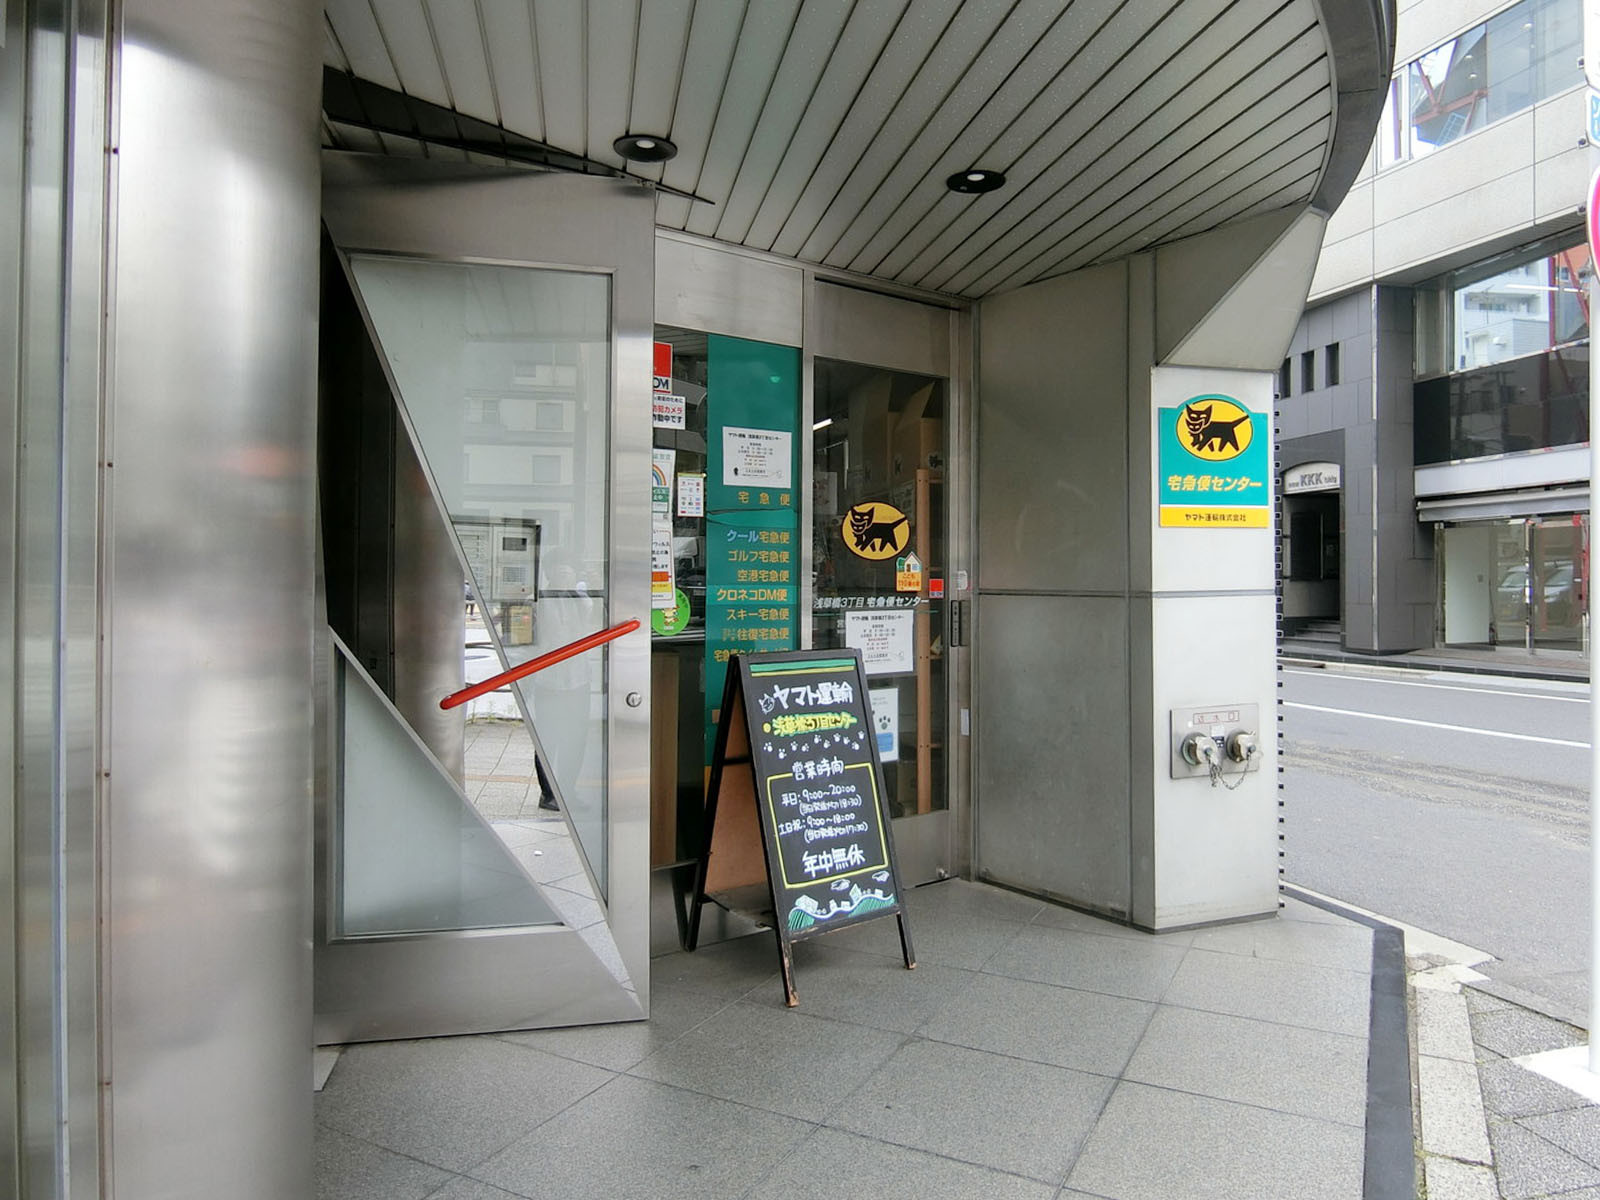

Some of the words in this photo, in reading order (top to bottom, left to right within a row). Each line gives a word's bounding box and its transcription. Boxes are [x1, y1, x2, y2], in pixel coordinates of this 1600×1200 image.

[1168, 474, 1263, 491] 宅急便センター
[1301, 471, 1323, 487] KKK
[738, 491, 790, 506] 宅急便
[1185, 513, 1247, 523] ヤマト運輸株式会社
[727, 529, 790, 544] クール宅急便
[728, 549, 790, 563] ゴルフ宅急便
[737, 569, 790, 583] 空港宅急便
[717, 589, 788, 601] クロネコDM便
[813, 597, 864, 609] 浅草橋3丁目
[866, 596, 930, 608] 宅急便センター
[727, 608, 790, 621] スキー宅急便
[773, 681, 853, 710] ヤマト運輸
[792, 757, 844, 780] 営業時間
[802, 844, 866, 878] 年中無休
